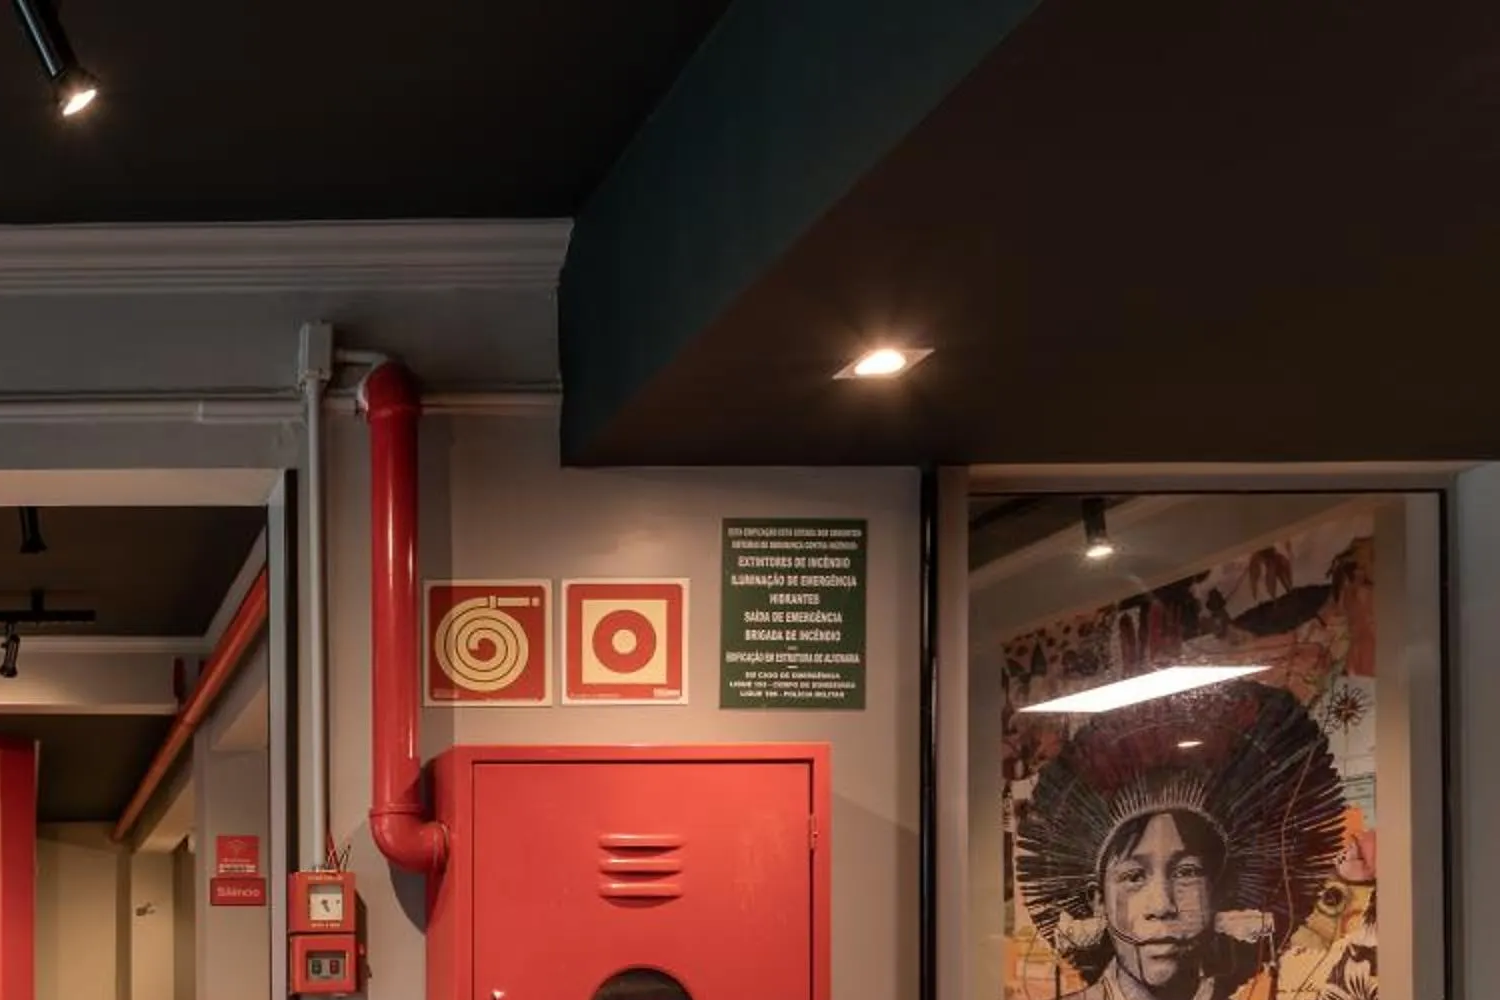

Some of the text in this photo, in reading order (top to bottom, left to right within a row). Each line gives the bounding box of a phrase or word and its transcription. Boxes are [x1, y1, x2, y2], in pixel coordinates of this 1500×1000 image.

[794, 557, 806, 569] DE
[787, 575, 799, 586] DE
[768, 593, 820, 605] HIDRANTES
[771, 611, 785, 622] DE
[745, 629, 784, 641] BRIGADA
[785, 630, 797, 641] DE
